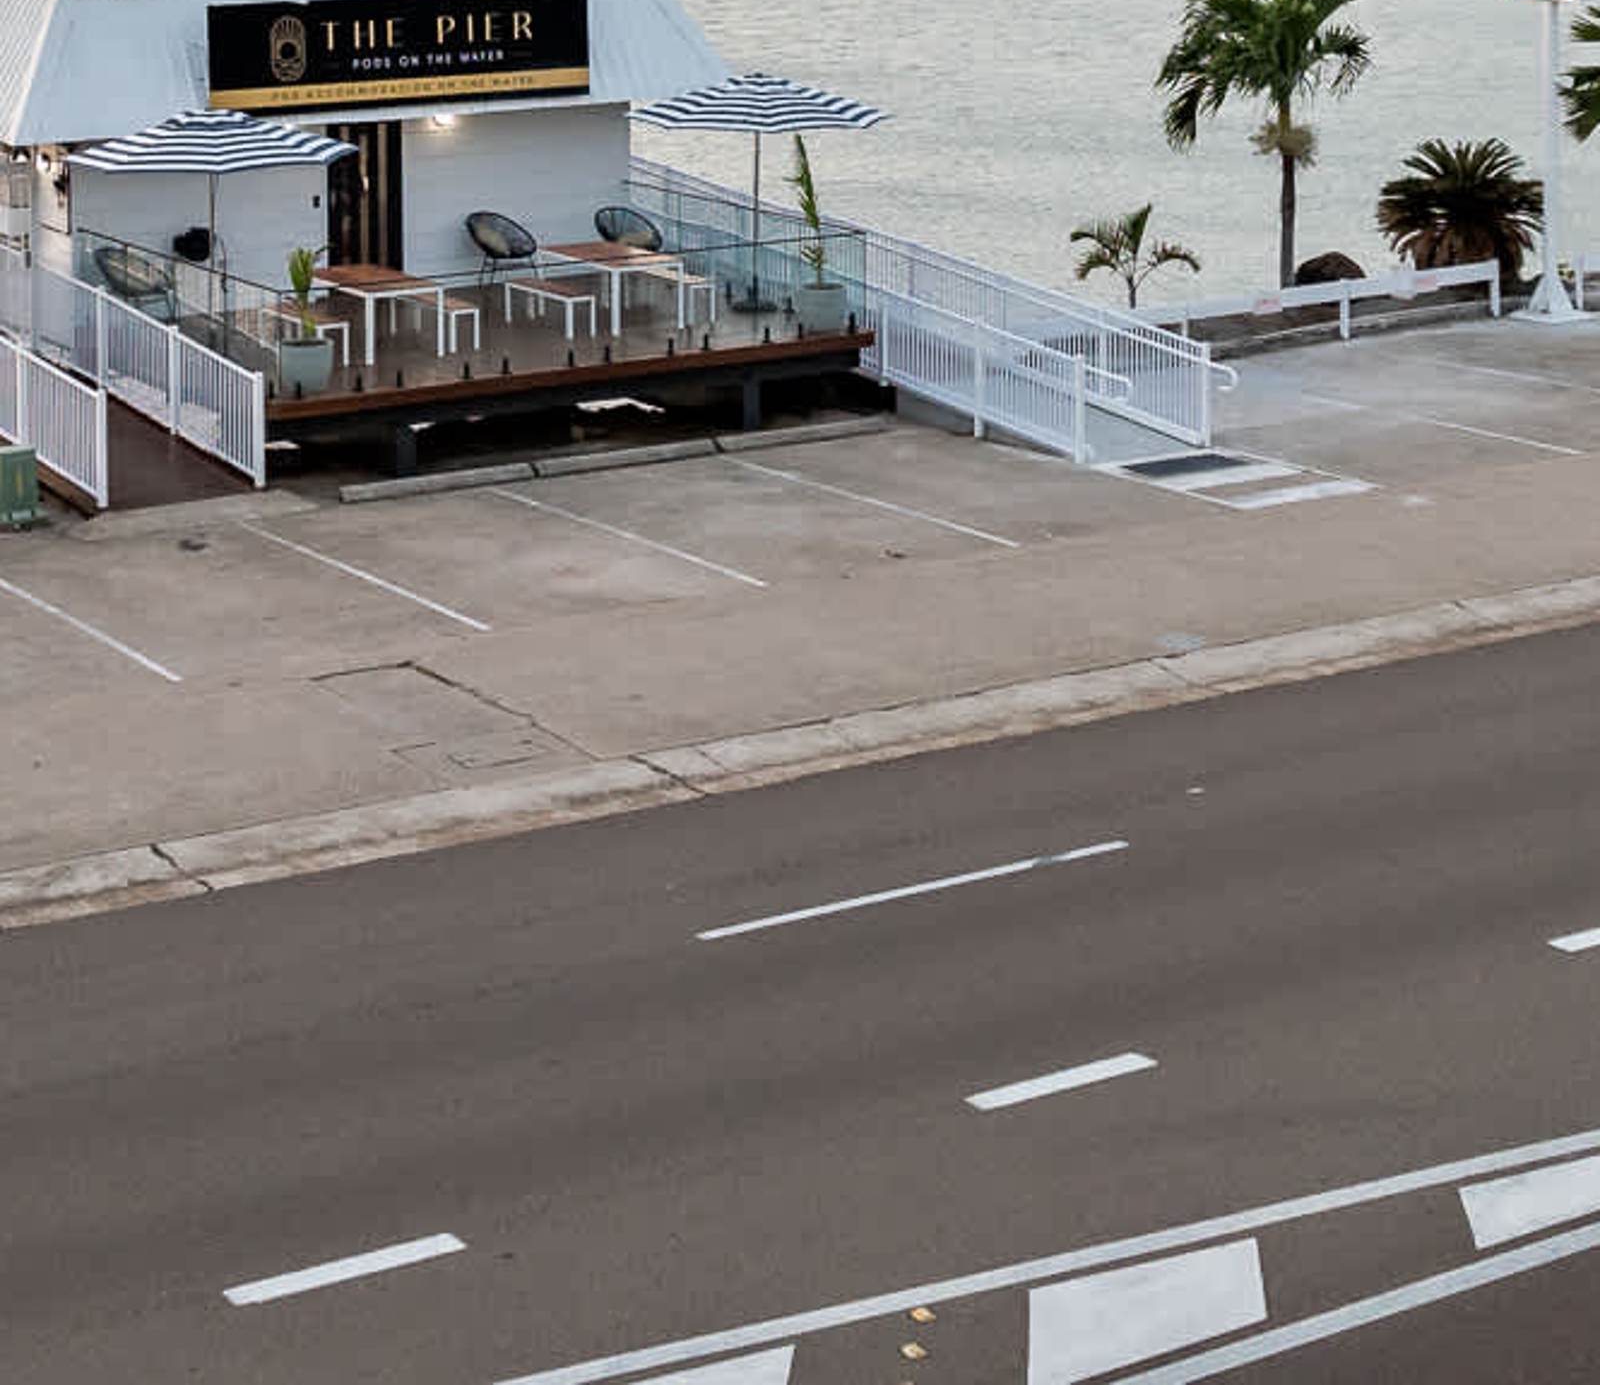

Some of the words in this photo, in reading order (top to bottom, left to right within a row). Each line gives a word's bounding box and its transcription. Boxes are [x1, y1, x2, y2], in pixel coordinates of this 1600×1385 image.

[319, 17, 404, 52] THE
[436, 11, 534, 45] PIER
[399, 55, 420, 68] ON
[427, 52, 452, 66] THE
[458, 49, 505, 63] WATER
